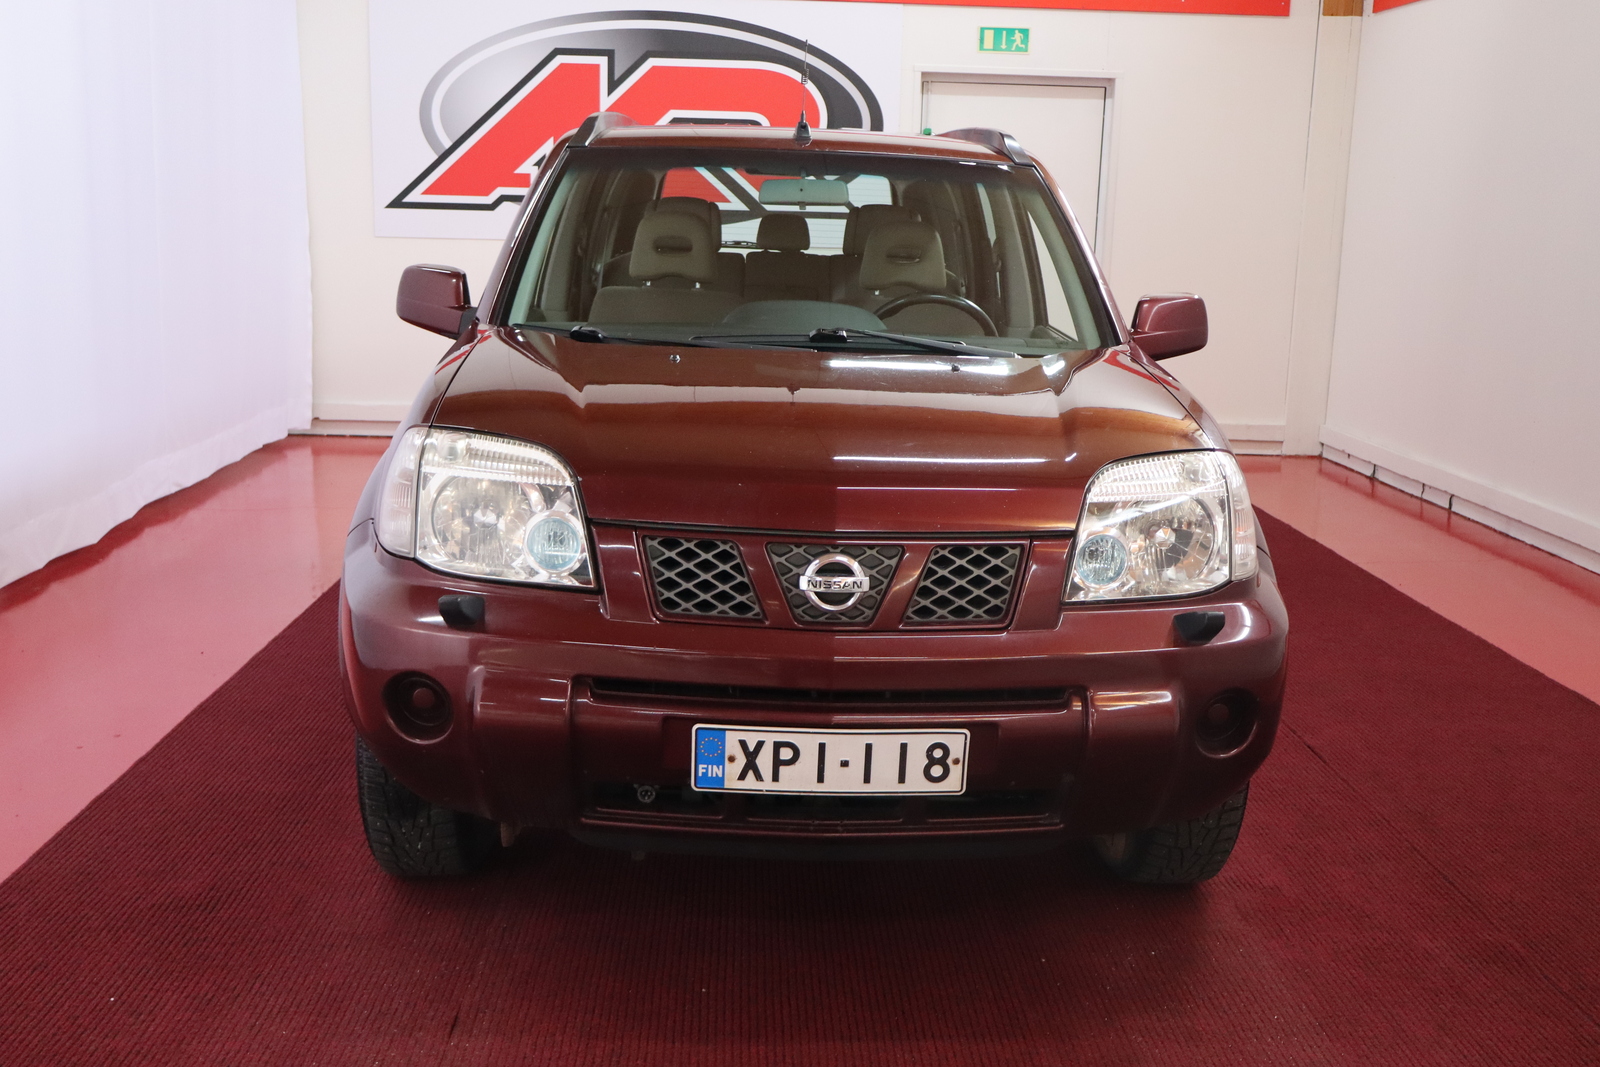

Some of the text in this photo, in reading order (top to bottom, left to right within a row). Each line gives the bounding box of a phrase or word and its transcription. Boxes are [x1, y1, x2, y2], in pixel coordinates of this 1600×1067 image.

[807, 579, 863, 590] NISSAN
[737, 738, 951, 784] XPI-118
[698, 764, 723, 778] FIN
